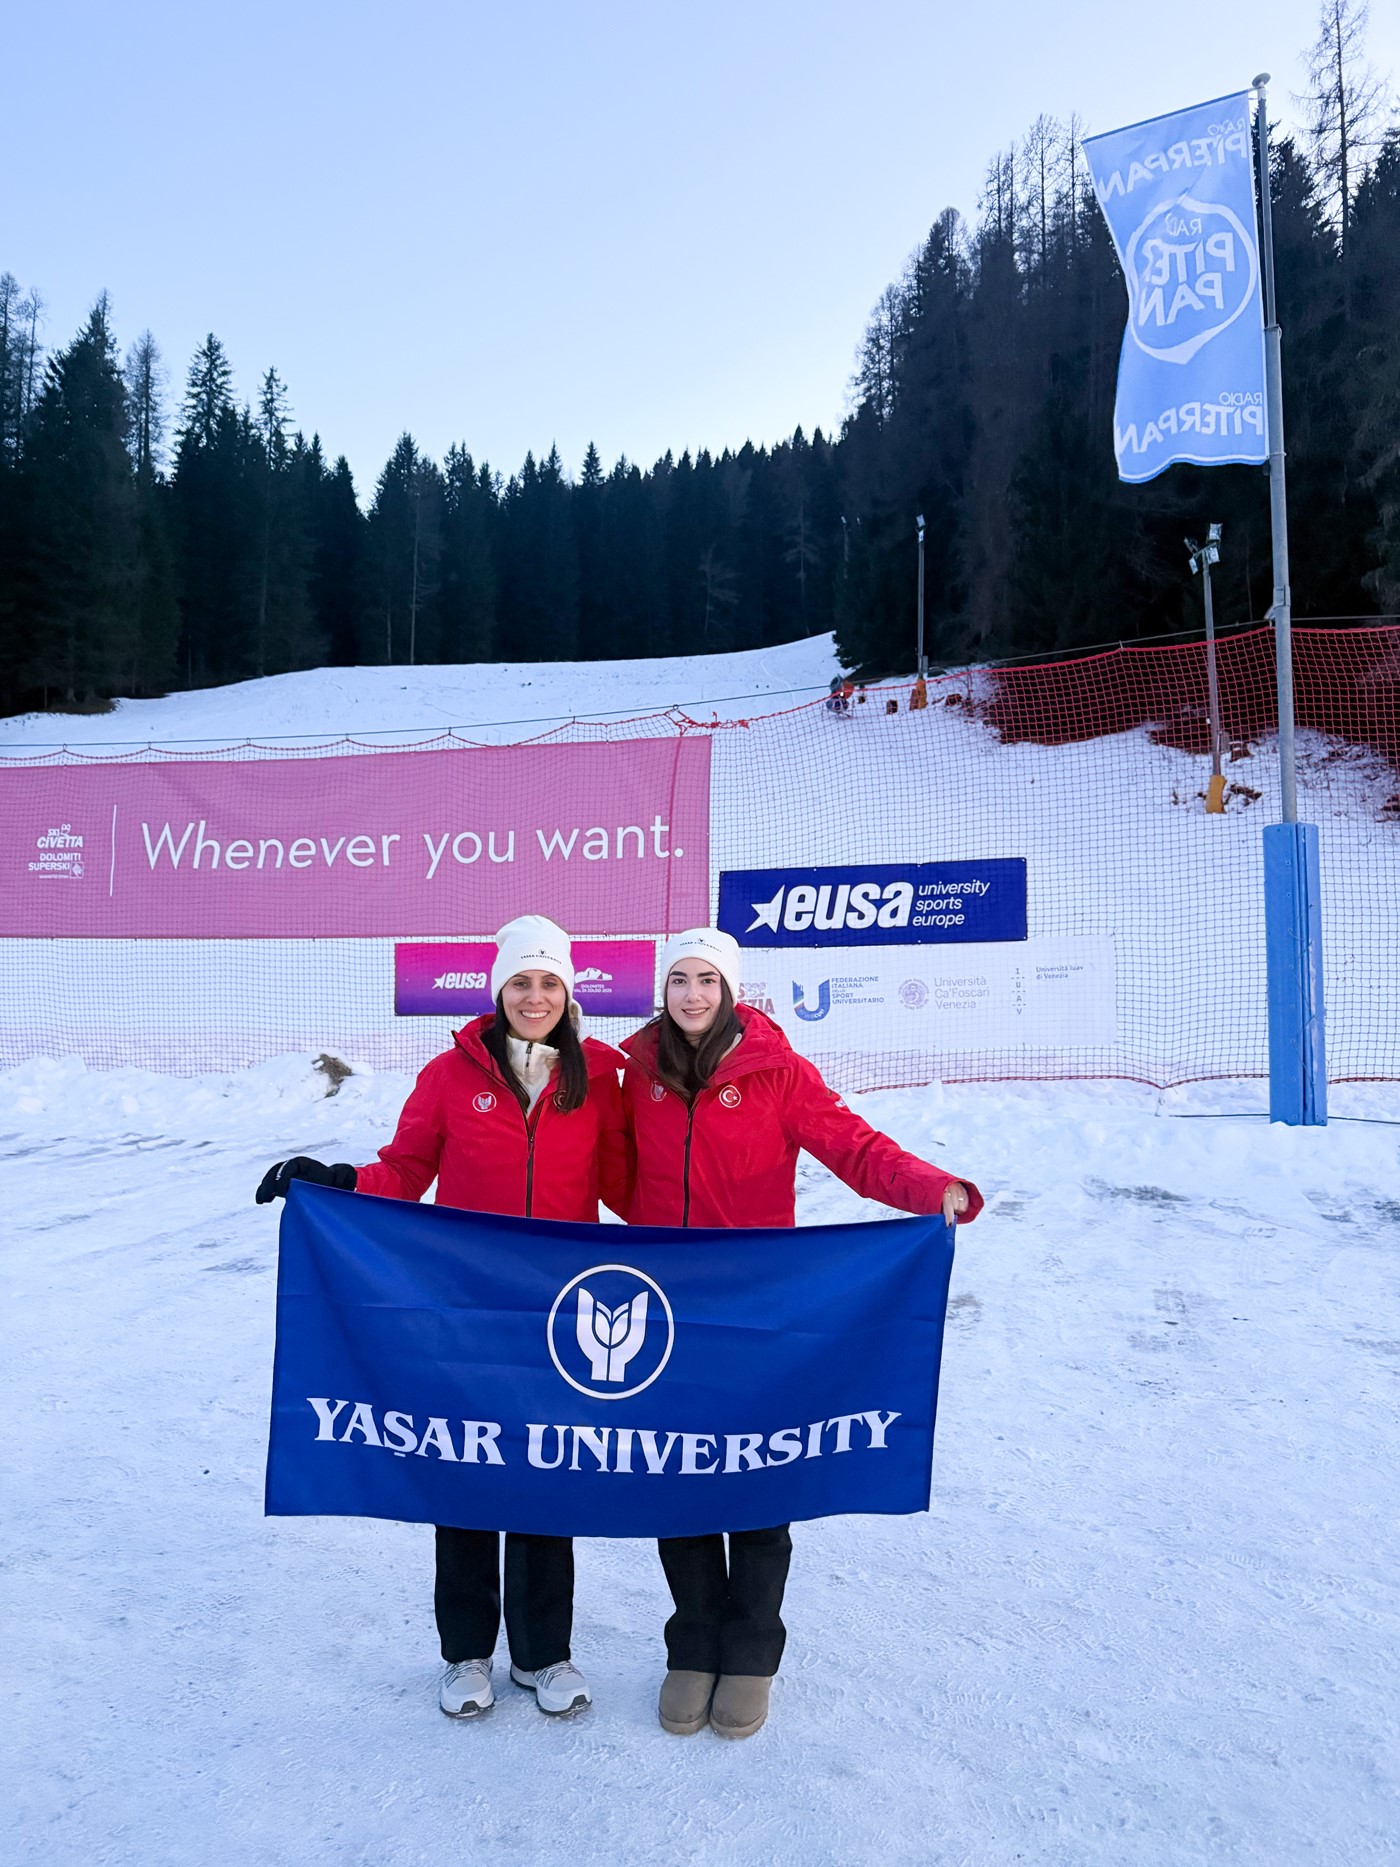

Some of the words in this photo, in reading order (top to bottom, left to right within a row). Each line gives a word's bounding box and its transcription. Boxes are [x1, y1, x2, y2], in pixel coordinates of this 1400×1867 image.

[47, 828, 60, 837] SKI
[141, 820, 401, 870] Whenever
[423, 831, 515, 880] you
[535, 815, 684, 861] want.
[40, 853, 81, 861] DOLOMITI
[28, 862, 70, 871] SUPERSKI
[918, 879, 991, 897] university
[783, 881, 914, 932] eusa
[915, 896, 963, 914] sports
[912, 913, 965, 929] europe
[444, 972, 488, 989] eusa
[935, 976, 987, 987] Università
[832, 997, 885, 1005] UNIVERSITARIO
[936, 1000, 977, 1010] Venezia
[306, 1397, 506, 1466] YAŞAR
[525, 1410, 902, 1475] UNIVERSITY
